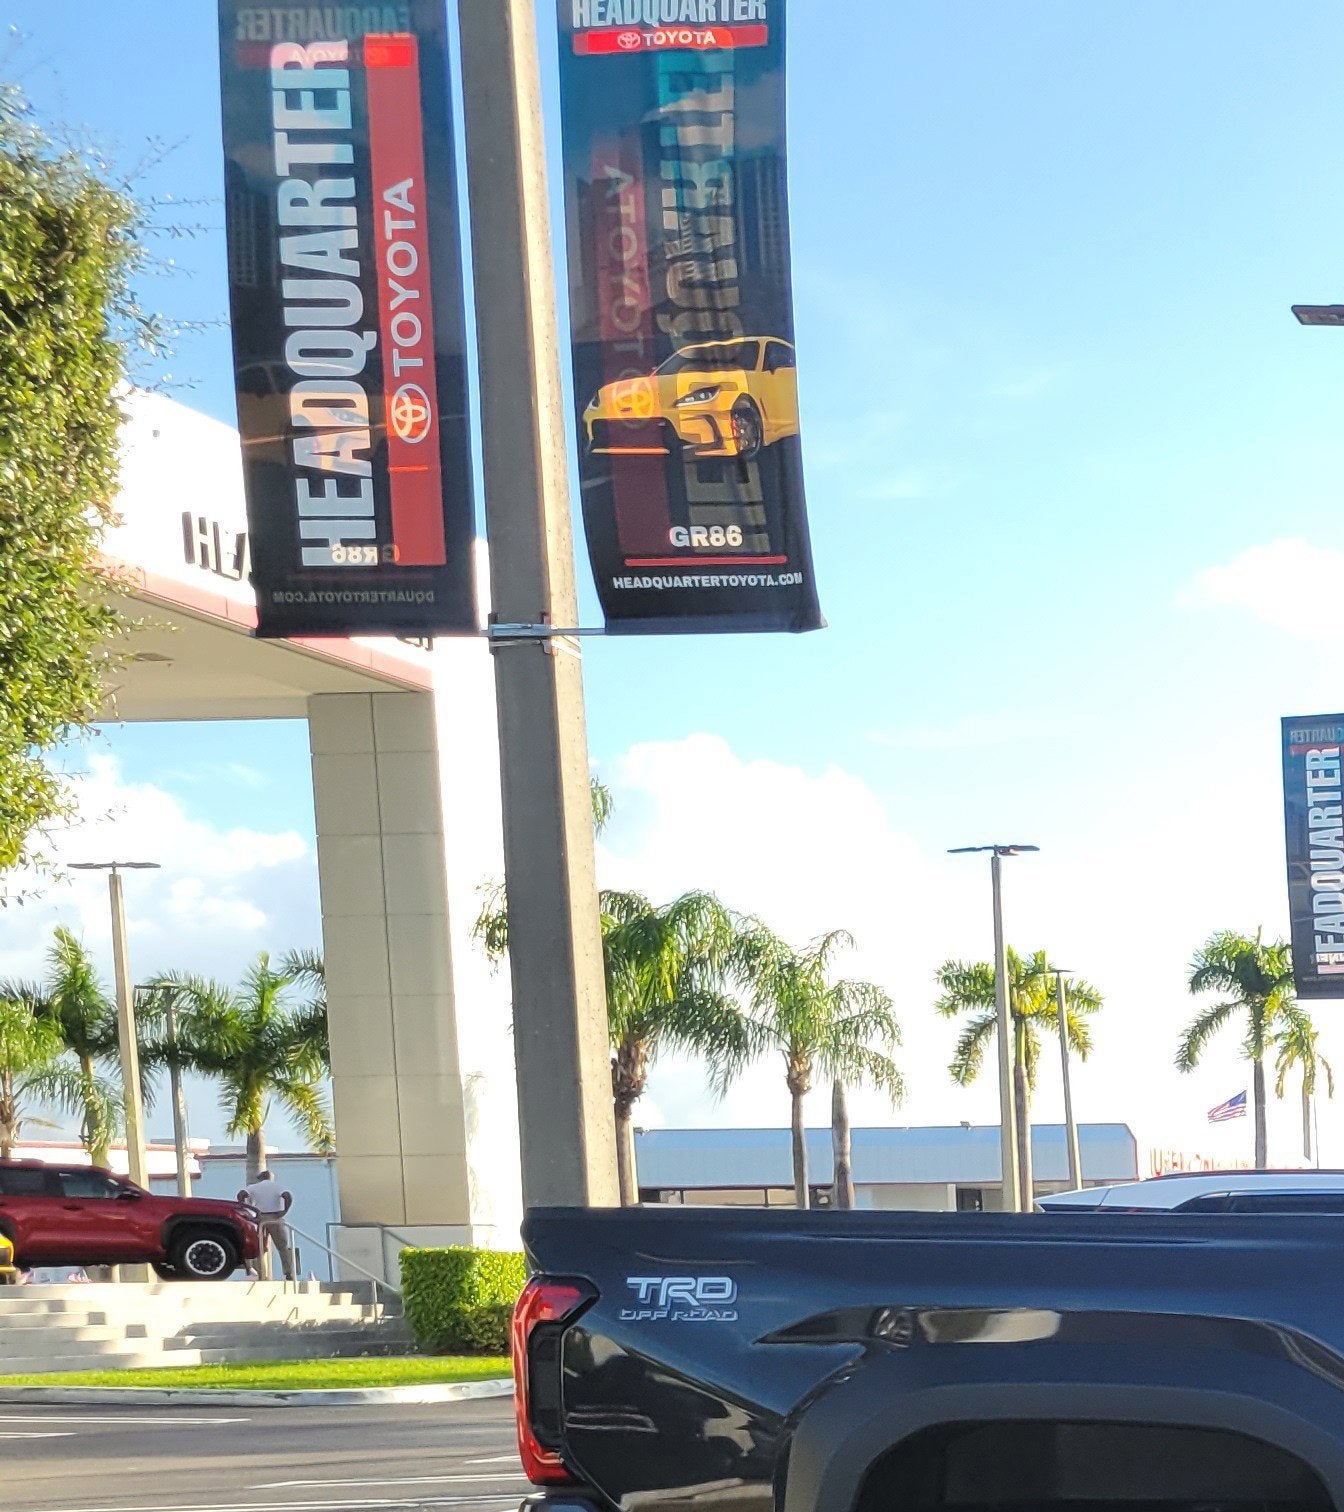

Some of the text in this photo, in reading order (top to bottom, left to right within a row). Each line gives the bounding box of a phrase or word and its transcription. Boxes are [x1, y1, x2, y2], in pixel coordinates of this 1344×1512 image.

[643, 31, 716, 47] TOYOTA
[383, 178, 425, 377] TOYOTA
[271, 39, 378, 566] HEADQUARTER
[669, 525, 743, 548] GR86
[613, 571, 803, 590] HEADQUARTERTOYOTA.COM
[627, 1277, 735, 1307] TRD
[619, 1308, 739, 1321] OFF ROAD
